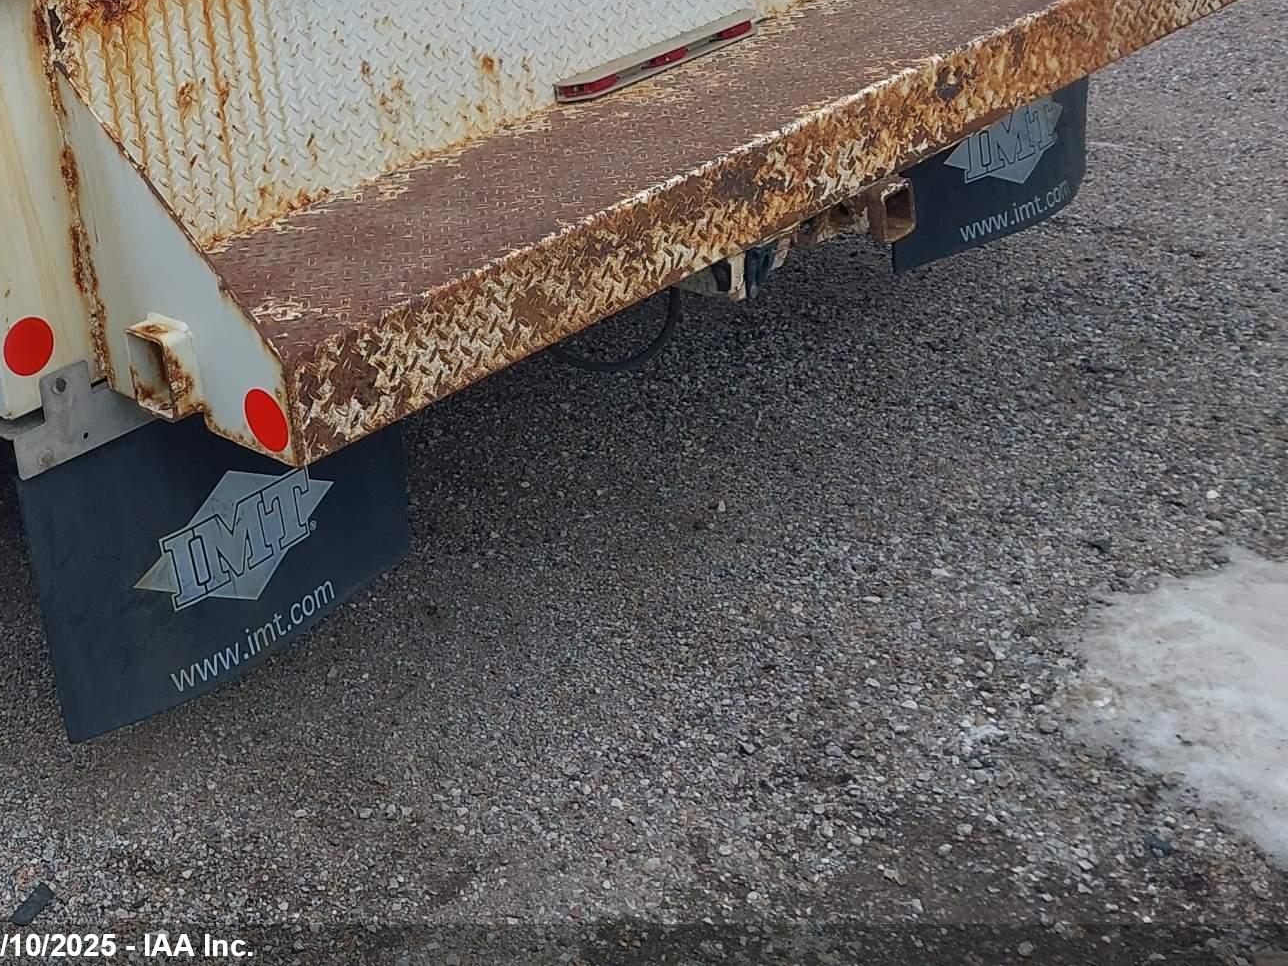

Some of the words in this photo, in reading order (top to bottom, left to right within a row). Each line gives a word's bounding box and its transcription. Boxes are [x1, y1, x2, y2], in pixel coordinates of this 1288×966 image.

[964, 103, 1058, 183] IMT
[960, 179, 1071, 243] www.imt.com
[160, 468, 310, 611] IMT
[170, 578, 336, 693] www.imt.com
